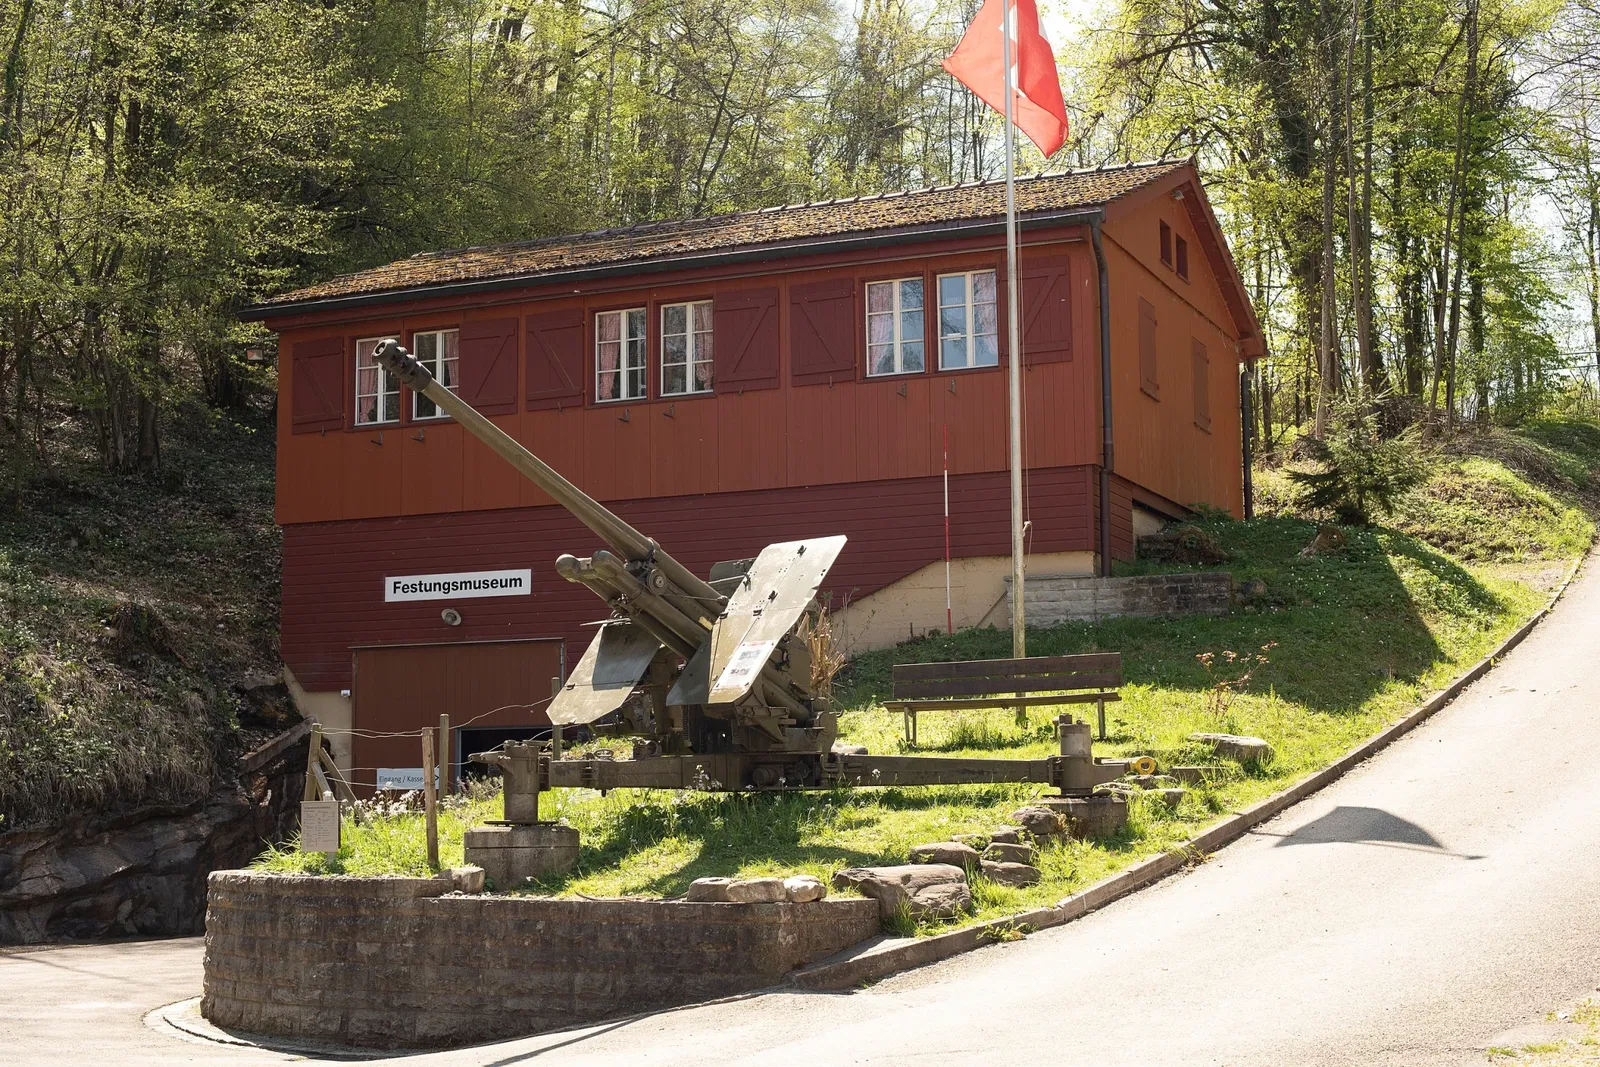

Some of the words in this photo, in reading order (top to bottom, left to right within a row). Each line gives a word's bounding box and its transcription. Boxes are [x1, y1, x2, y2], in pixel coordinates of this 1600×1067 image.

[393, 577, 523, 594] Festungsmuseum
[379, 775, 402, 783] Eingang
[407, 775, 424, 783] Kasse
